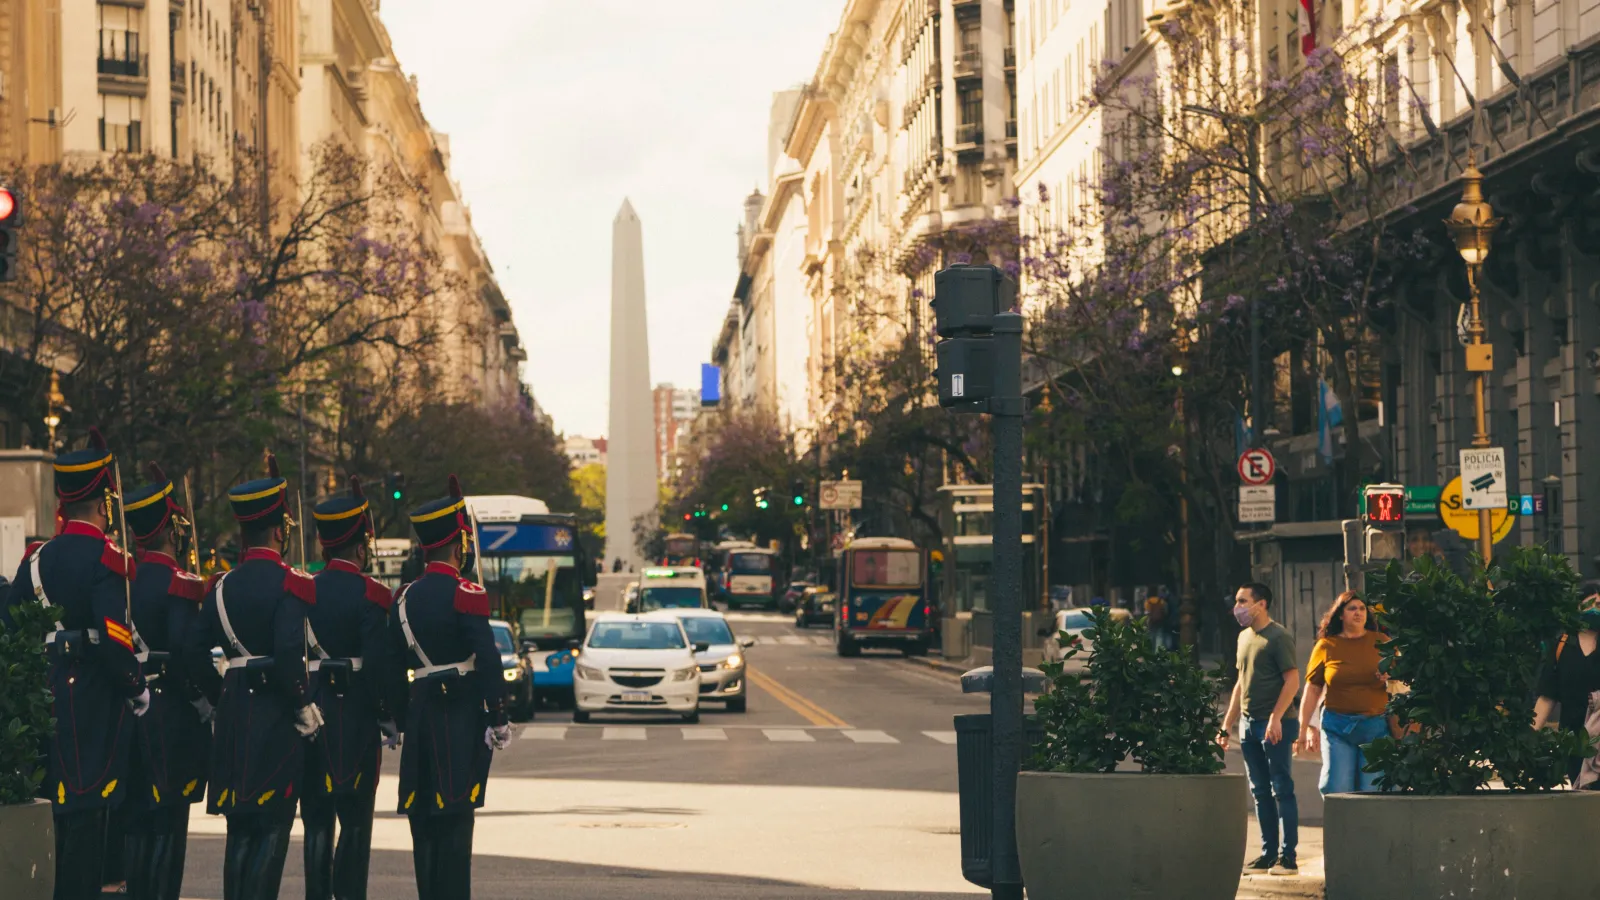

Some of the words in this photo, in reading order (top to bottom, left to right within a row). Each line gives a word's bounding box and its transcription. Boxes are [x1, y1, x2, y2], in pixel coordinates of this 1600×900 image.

[1250, 456, 1263, 477] E
[1509, 500, 1519, 511] D
[1521, 499, 1532, 511] A
[1535, 500, 1543, 512] E
